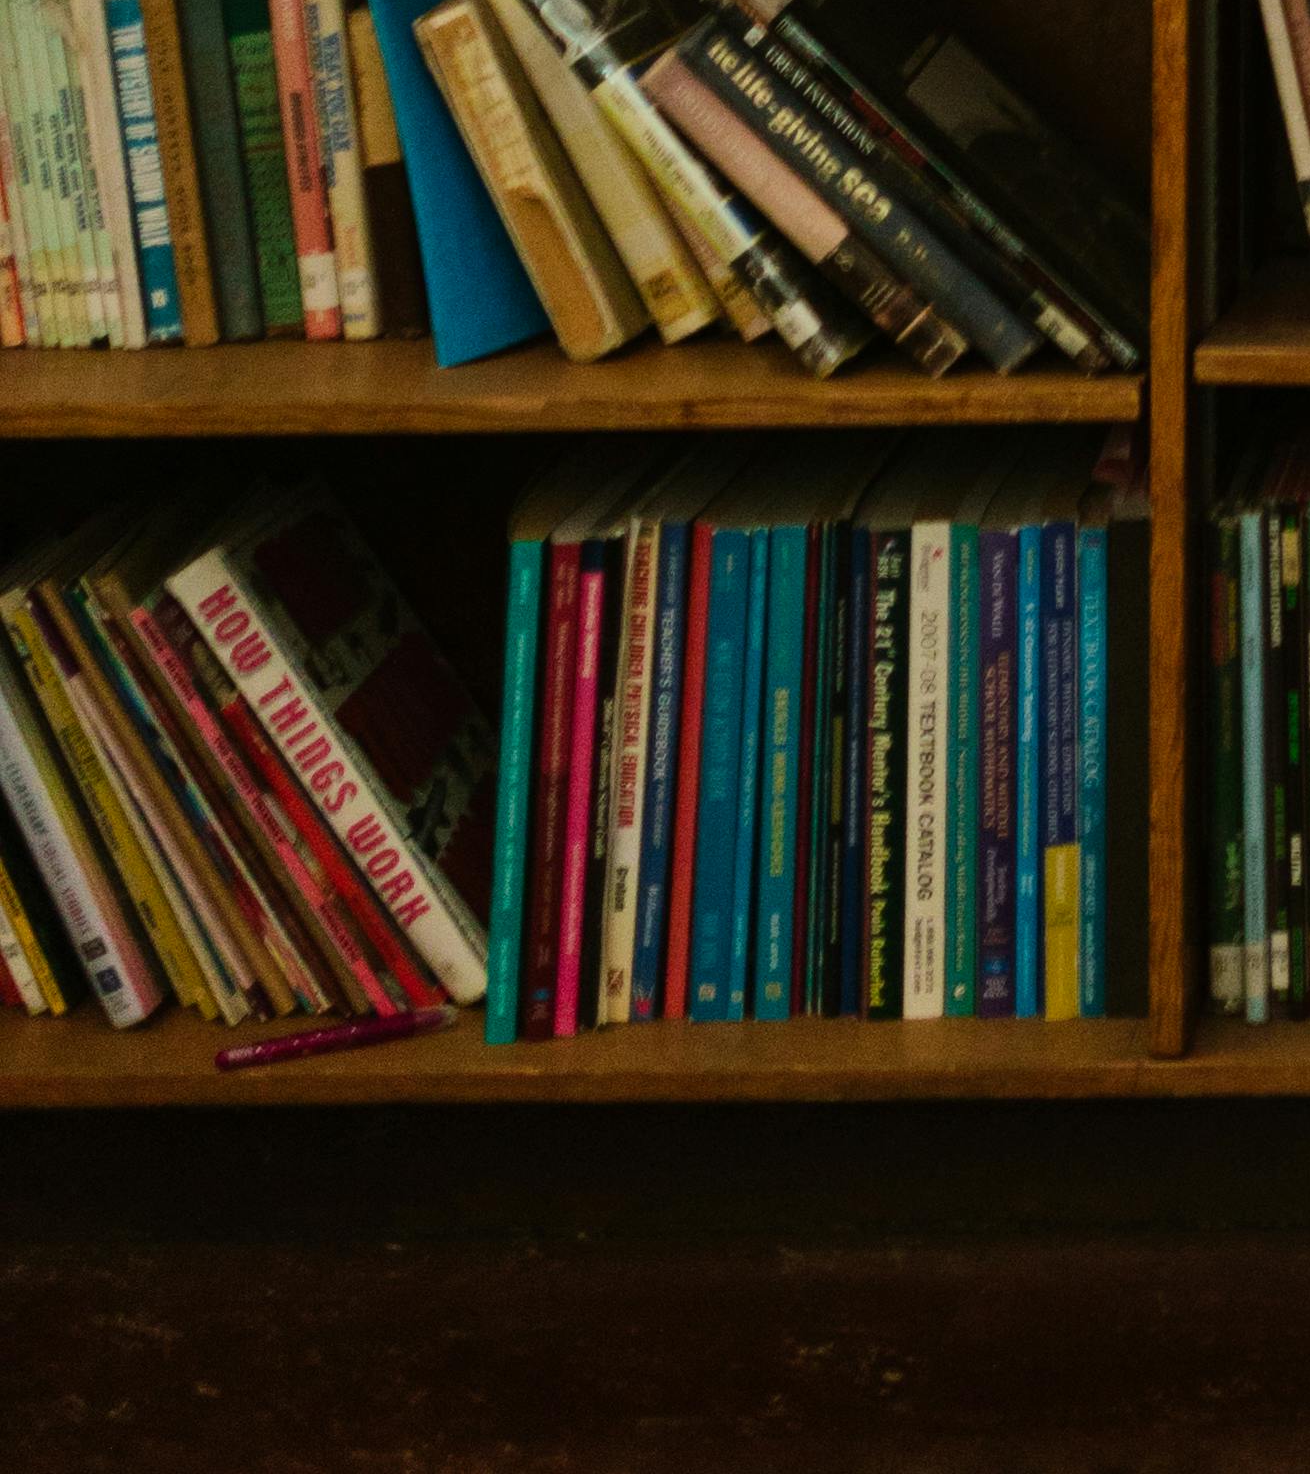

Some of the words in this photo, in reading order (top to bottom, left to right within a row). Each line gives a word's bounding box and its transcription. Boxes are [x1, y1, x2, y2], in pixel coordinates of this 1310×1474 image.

[199, 584, 273, 673] HOW
[258, 674, 359, 813] THINGS
[347, 813, 432, 927] WORK
[917, 699, 938, 807] TEXTBOOK
[916, 815, 935, 901] CATALOG
